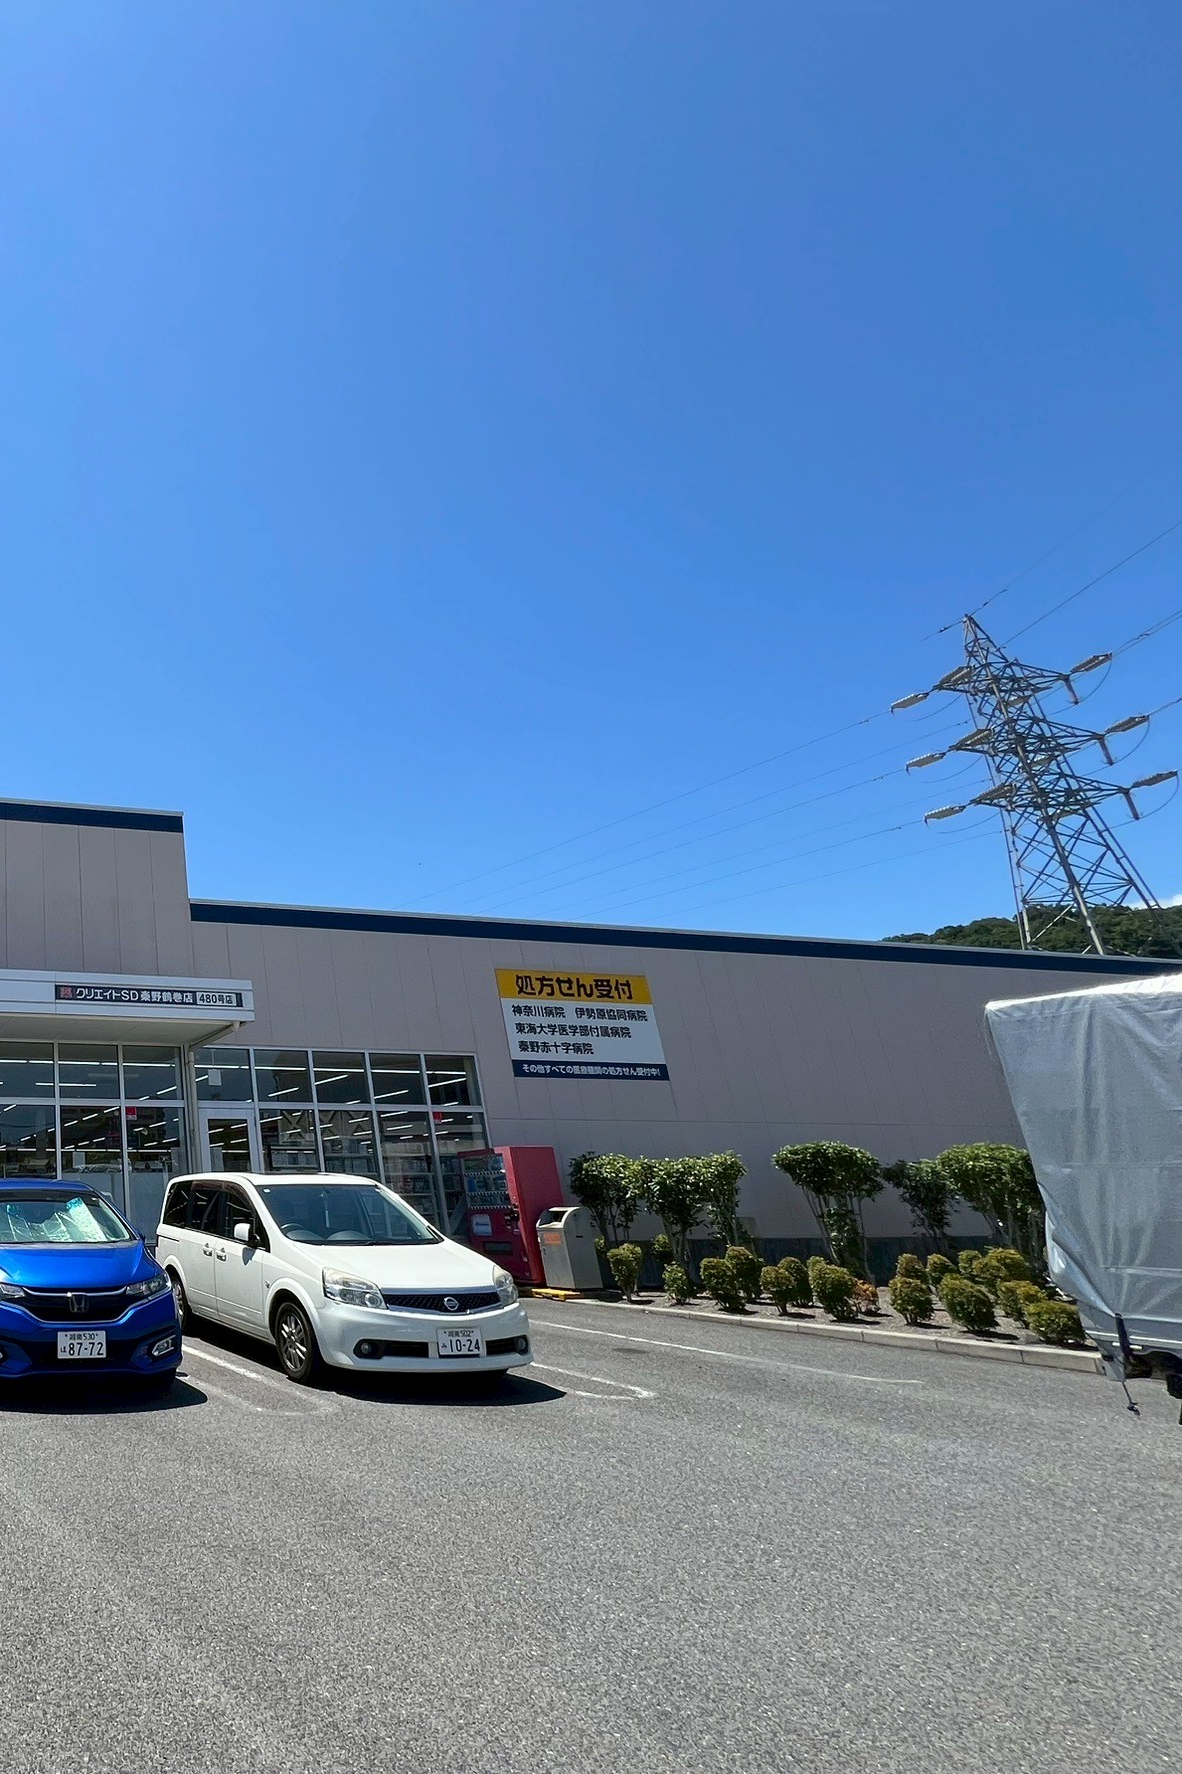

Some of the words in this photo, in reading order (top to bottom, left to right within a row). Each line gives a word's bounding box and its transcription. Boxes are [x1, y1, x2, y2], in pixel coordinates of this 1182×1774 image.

[515, 974, 634, 1000] 処方せん受付
[512, 1004, 566, 1019] 神奈川病院
[575, 1007, 649, 1022] 伊勢原協同病院
[515, 1022, 632, 1039] 東海大学医学部付属病院
[518, 1040, 595, 1055] 秦野赤十字病院
[68, 1341, 104, 1356] 87-72
[449, 1338, 481, 1353] 10-24
